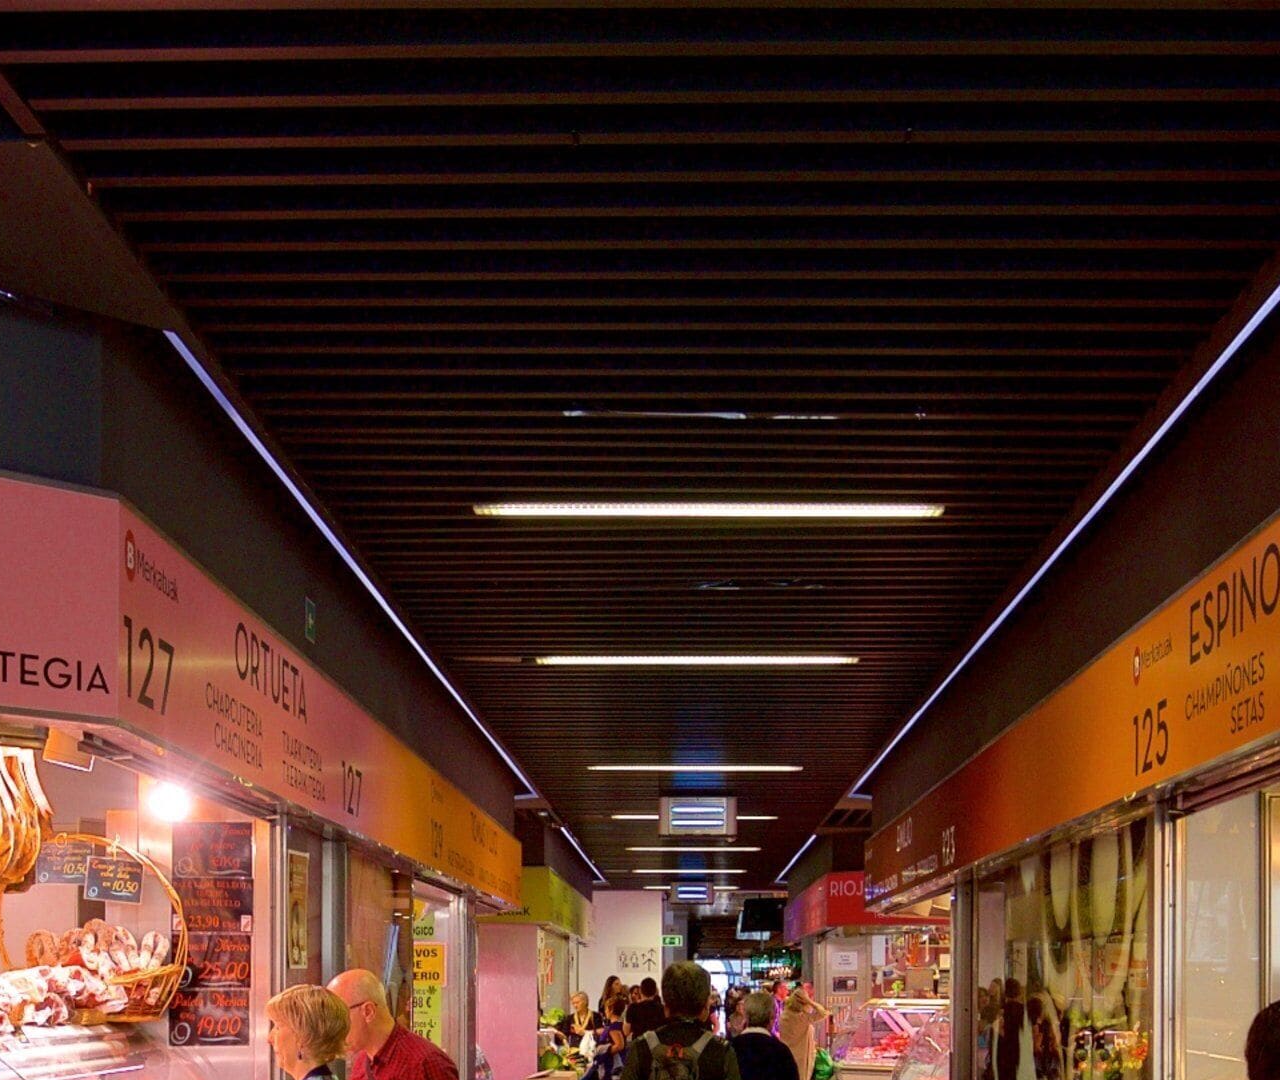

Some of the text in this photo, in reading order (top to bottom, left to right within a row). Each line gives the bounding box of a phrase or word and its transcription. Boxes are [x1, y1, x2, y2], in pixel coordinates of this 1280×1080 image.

[123, 614, 175, 716] 127
[234, 621, 308, 724] ORTUETA
[1185, 651, 1265, 721] CHAMPIÑONES
[205, 681, 263, 738] CHARCUTERIA
[1133, 698, 1169, 777] 125
[1230, 691, 1265, 734] SETAS
[214, 722, 264, 771] CHACINERIA
[341, 759, 363, 818] 127
[413, 949, 438, 957] VOS
[197, 1014, 242, 1037] 19,00
